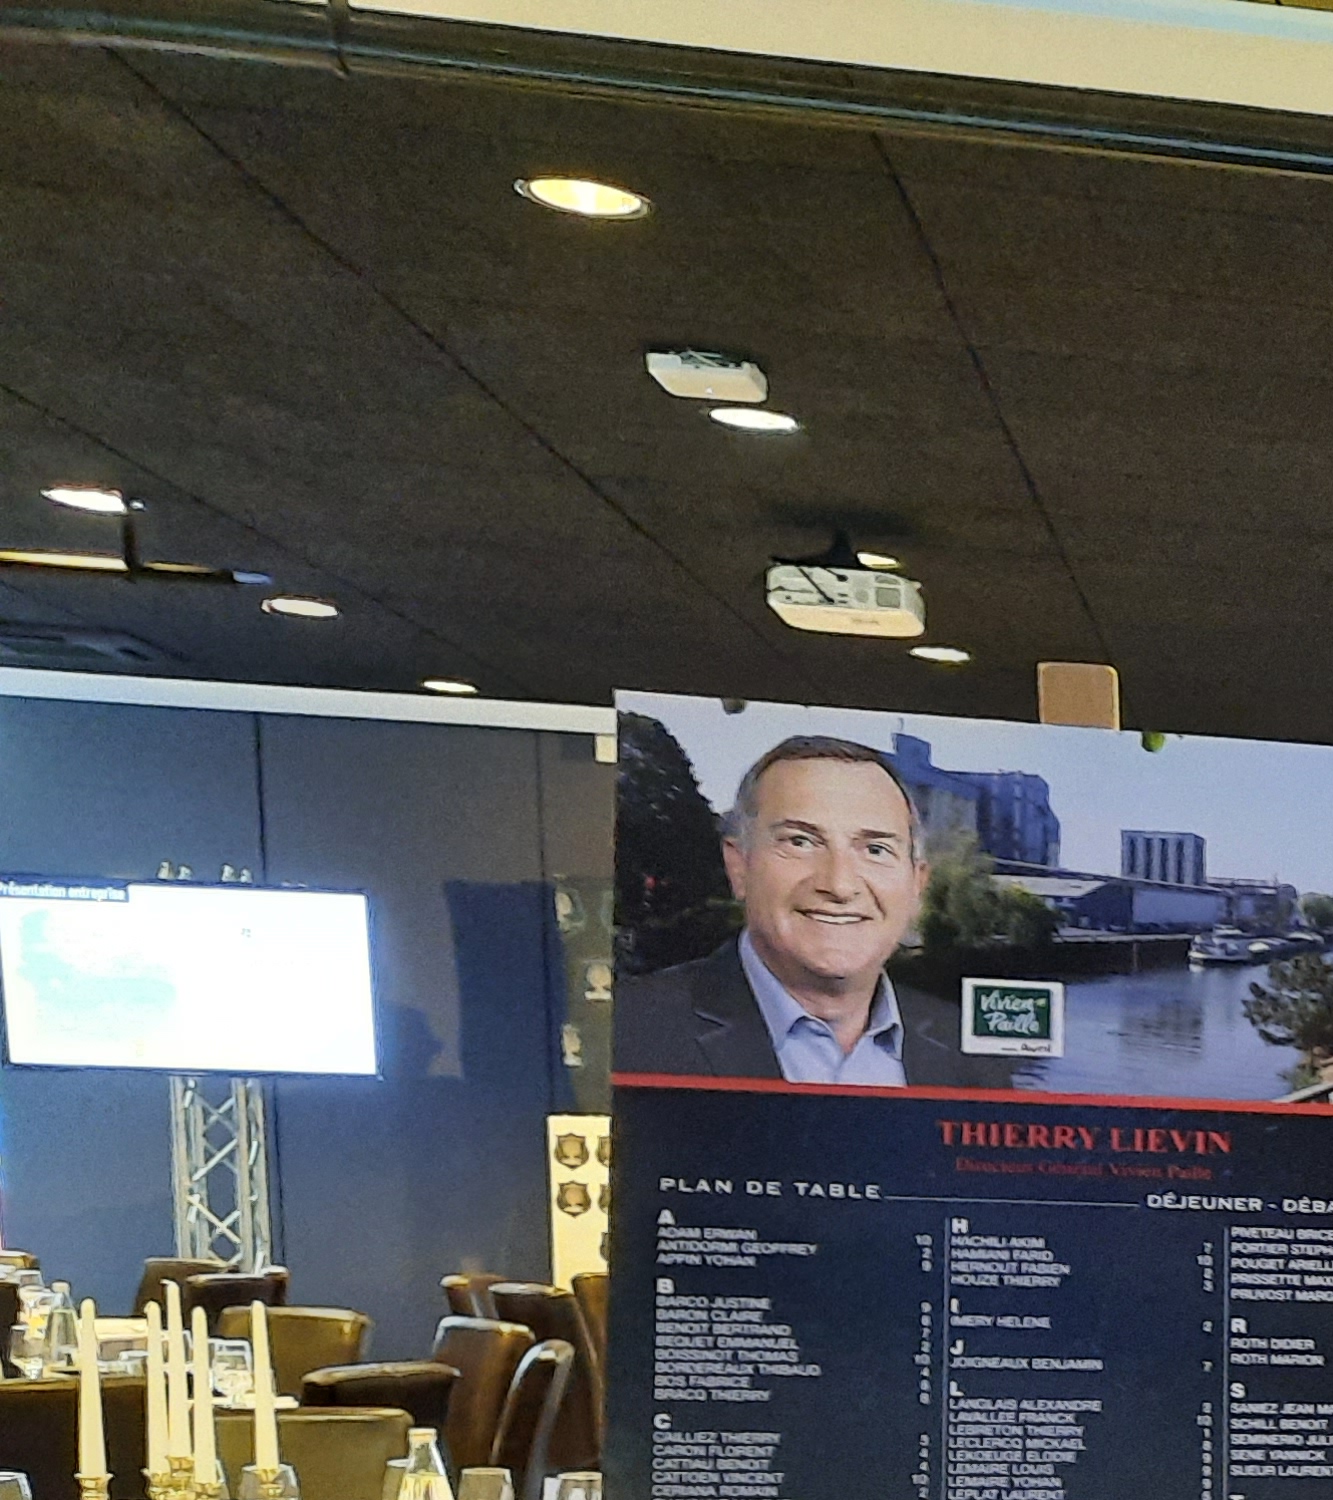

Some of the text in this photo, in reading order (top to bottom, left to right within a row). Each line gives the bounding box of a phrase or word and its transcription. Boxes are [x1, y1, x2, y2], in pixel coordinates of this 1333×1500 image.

[983, 1011, 1039, 1034] Paille
[938, 1119, 1232, 1155] THIERRY LIEVIN
[659, 1177, 881, 1199] PLAN DE TABLE
[1147, 1191, 1262, 1211] DÉJEUNER
[657, 1209, 675, 1224] A
[952, 1218, 968, 1233] H
[656, 1278, 674, 1293] B
[1231, 1318, 1247, 1333] R
[951, 1340, 964, 1354] J
[950, 1381, 964, 1396] L
[1230, 1383, 1245, 1398] S
[654, 1414, 672, 1429] C
